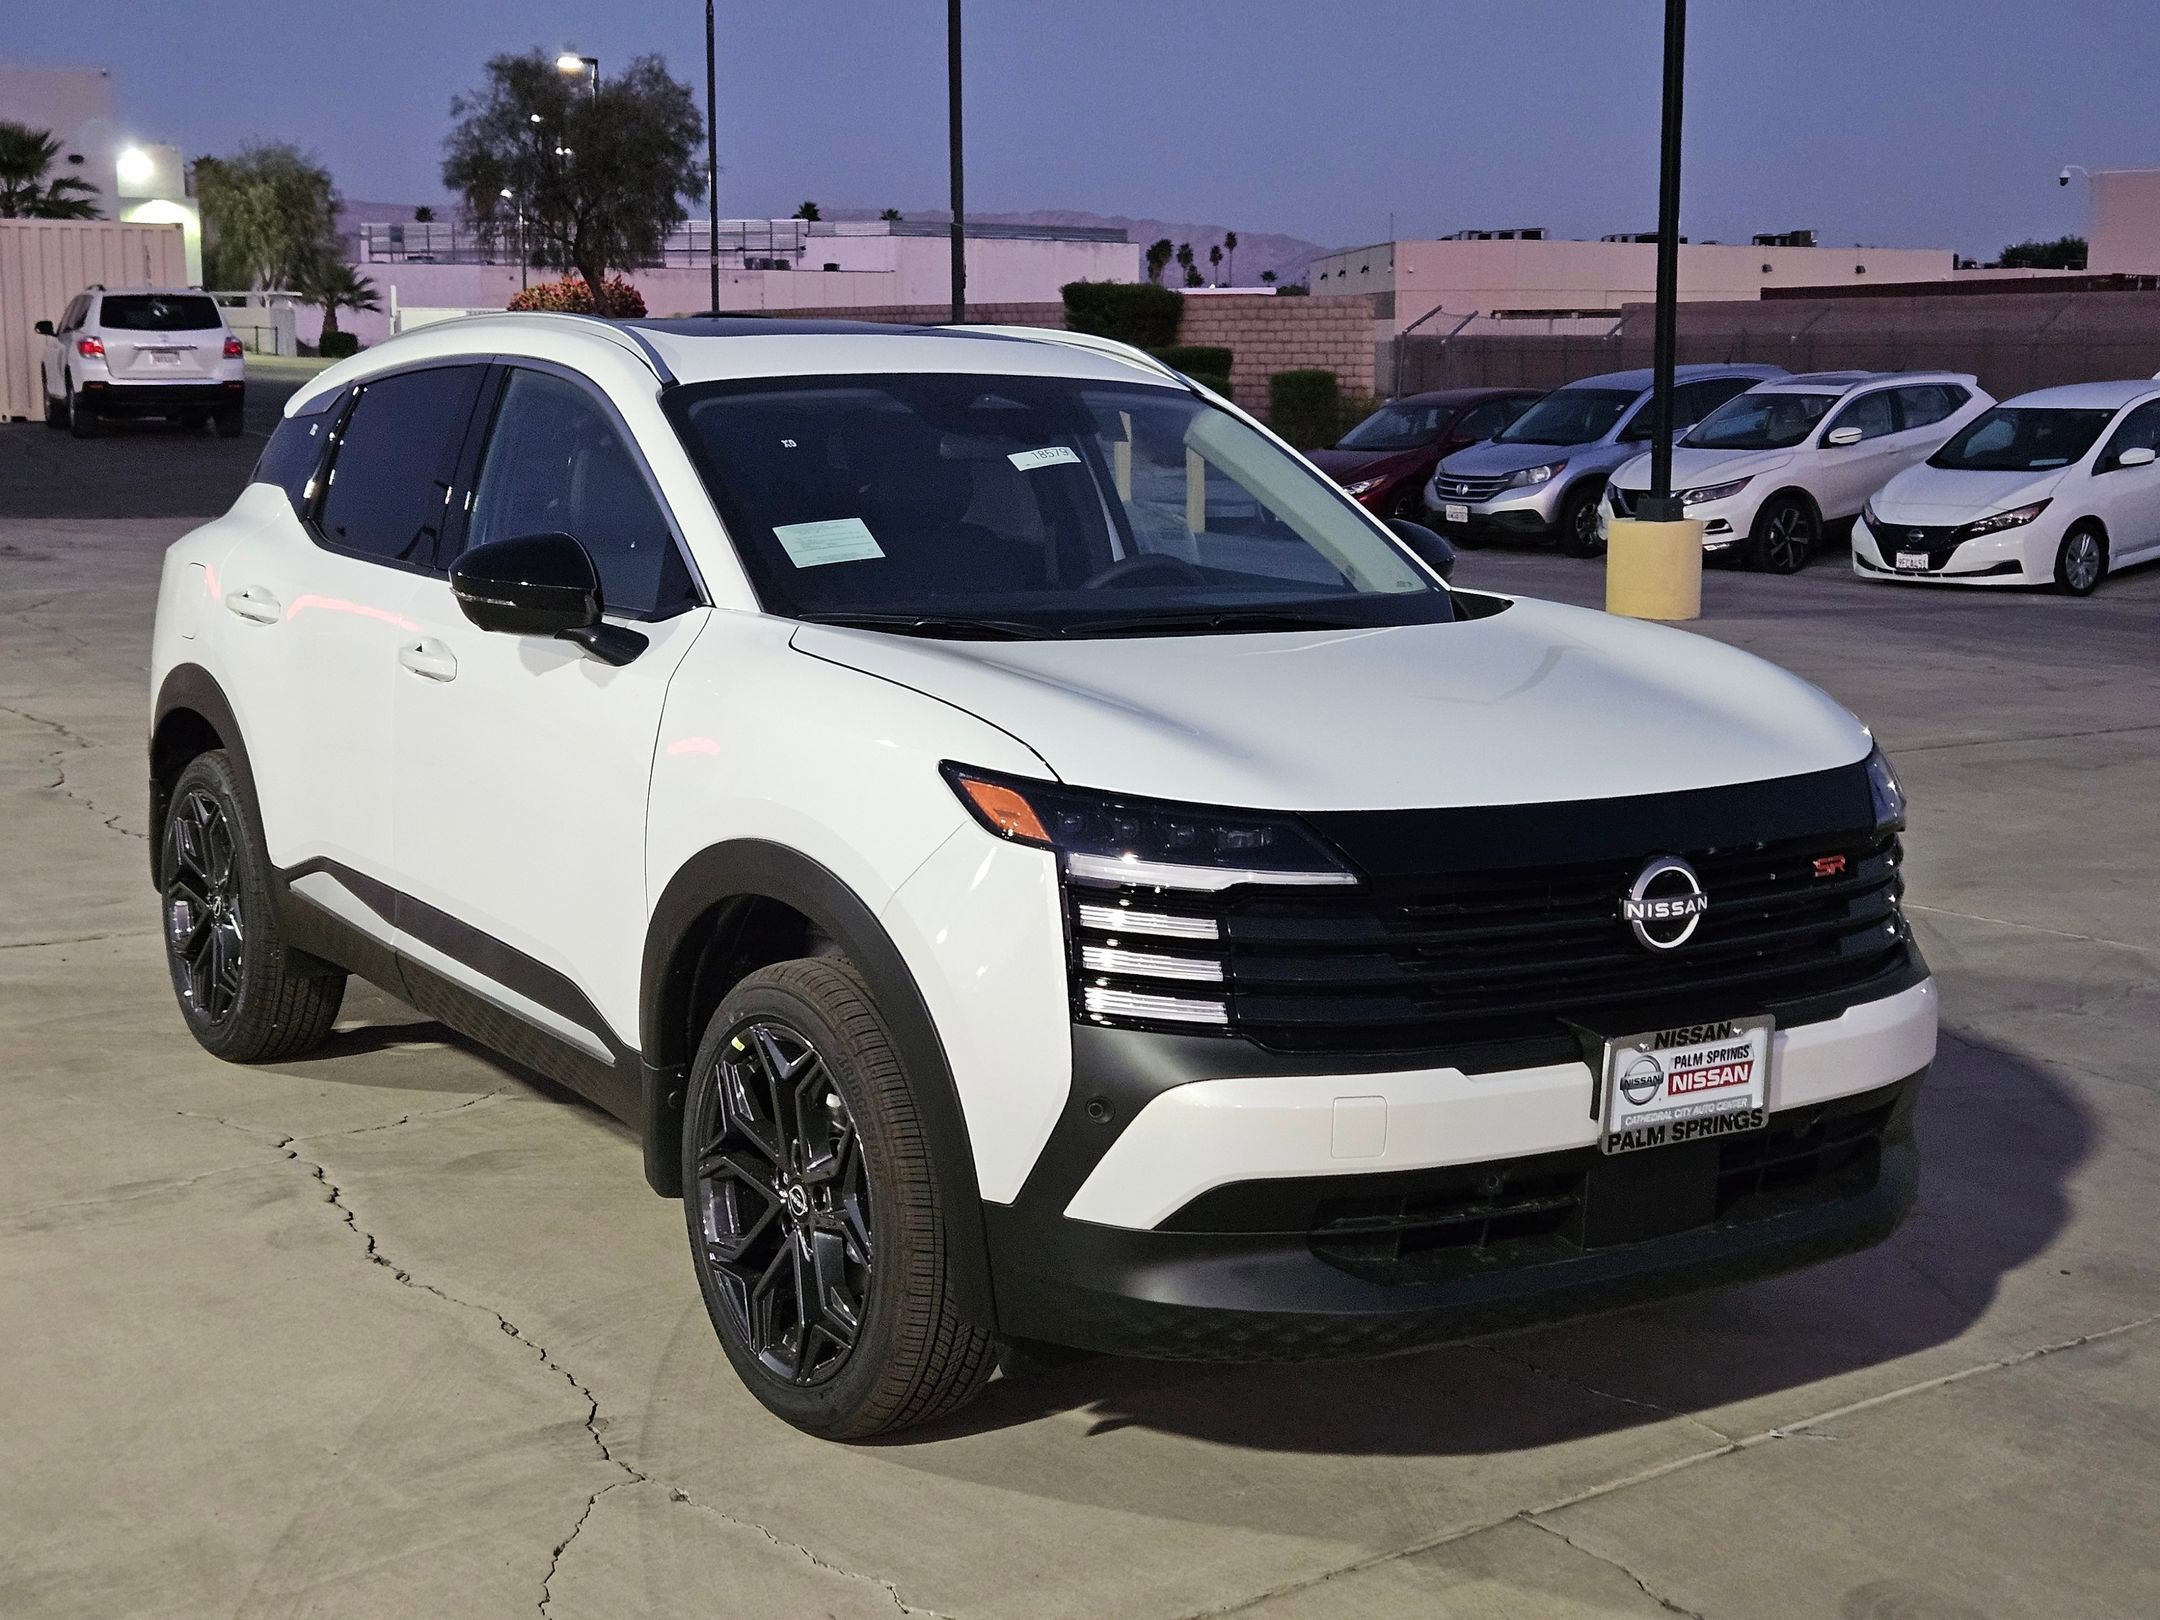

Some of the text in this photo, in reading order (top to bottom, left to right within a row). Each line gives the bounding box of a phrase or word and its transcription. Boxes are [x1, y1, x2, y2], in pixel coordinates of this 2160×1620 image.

[1031, 448, 1069, 461] 18579
[1812, 855, 1845, 877] SR
[1626, 896, 1708, 919] NISSAN
[1654, 1022, 1732, 1050] NISSAN
[1674, 1045, 1750, 1070] PALM SPRINGS
[1624, 1075, 1661, 1087] NISSAN
[1672, 1064, 1749, 1093] NISSAN
[1625, 1099, 1748, 1126] CATHEDRAL CITY AUTO CENTER
[1607, 1108, 1763, 1153] PALM SPRINGS
